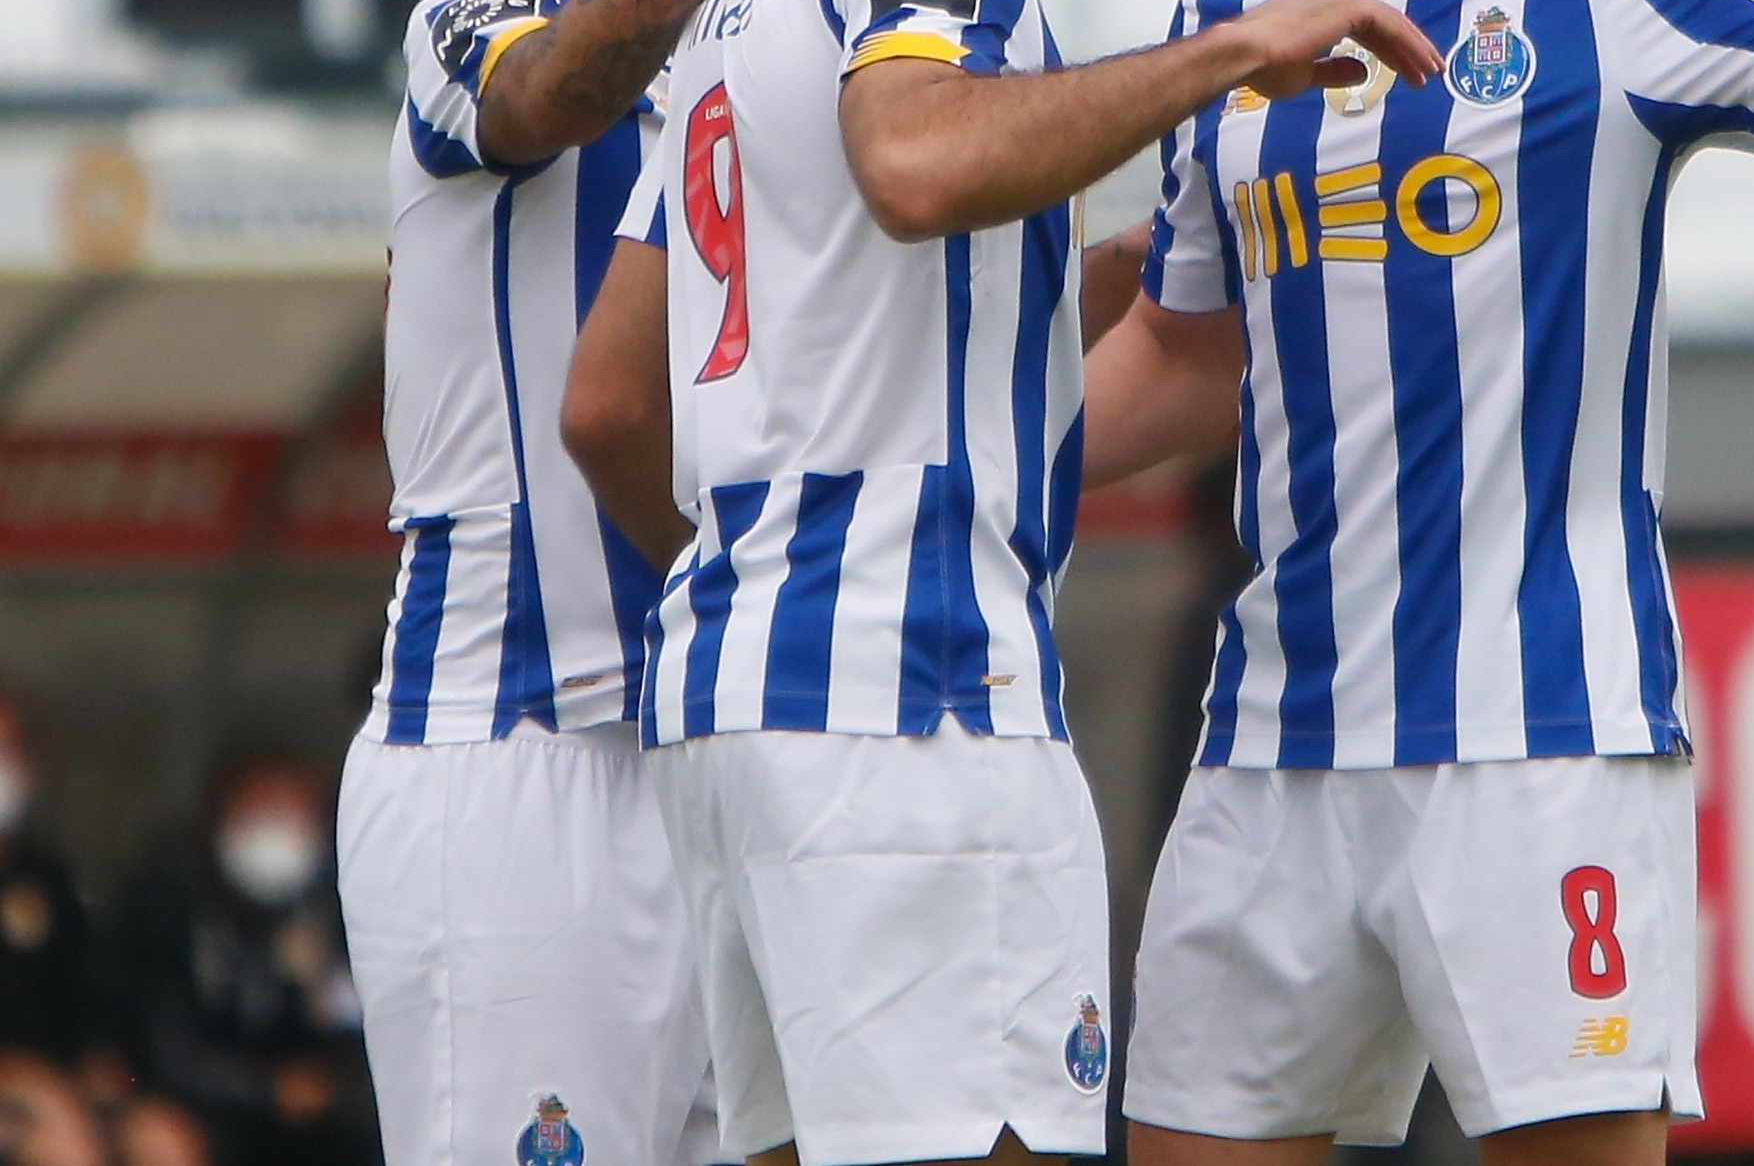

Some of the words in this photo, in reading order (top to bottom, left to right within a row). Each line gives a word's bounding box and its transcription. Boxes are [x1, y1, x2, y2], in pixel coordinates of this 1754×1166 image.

[684, 80, 750, 386] 9
[1234, 153, 1502, 282] MEO
[1561, 865, 1627, 999] 8
